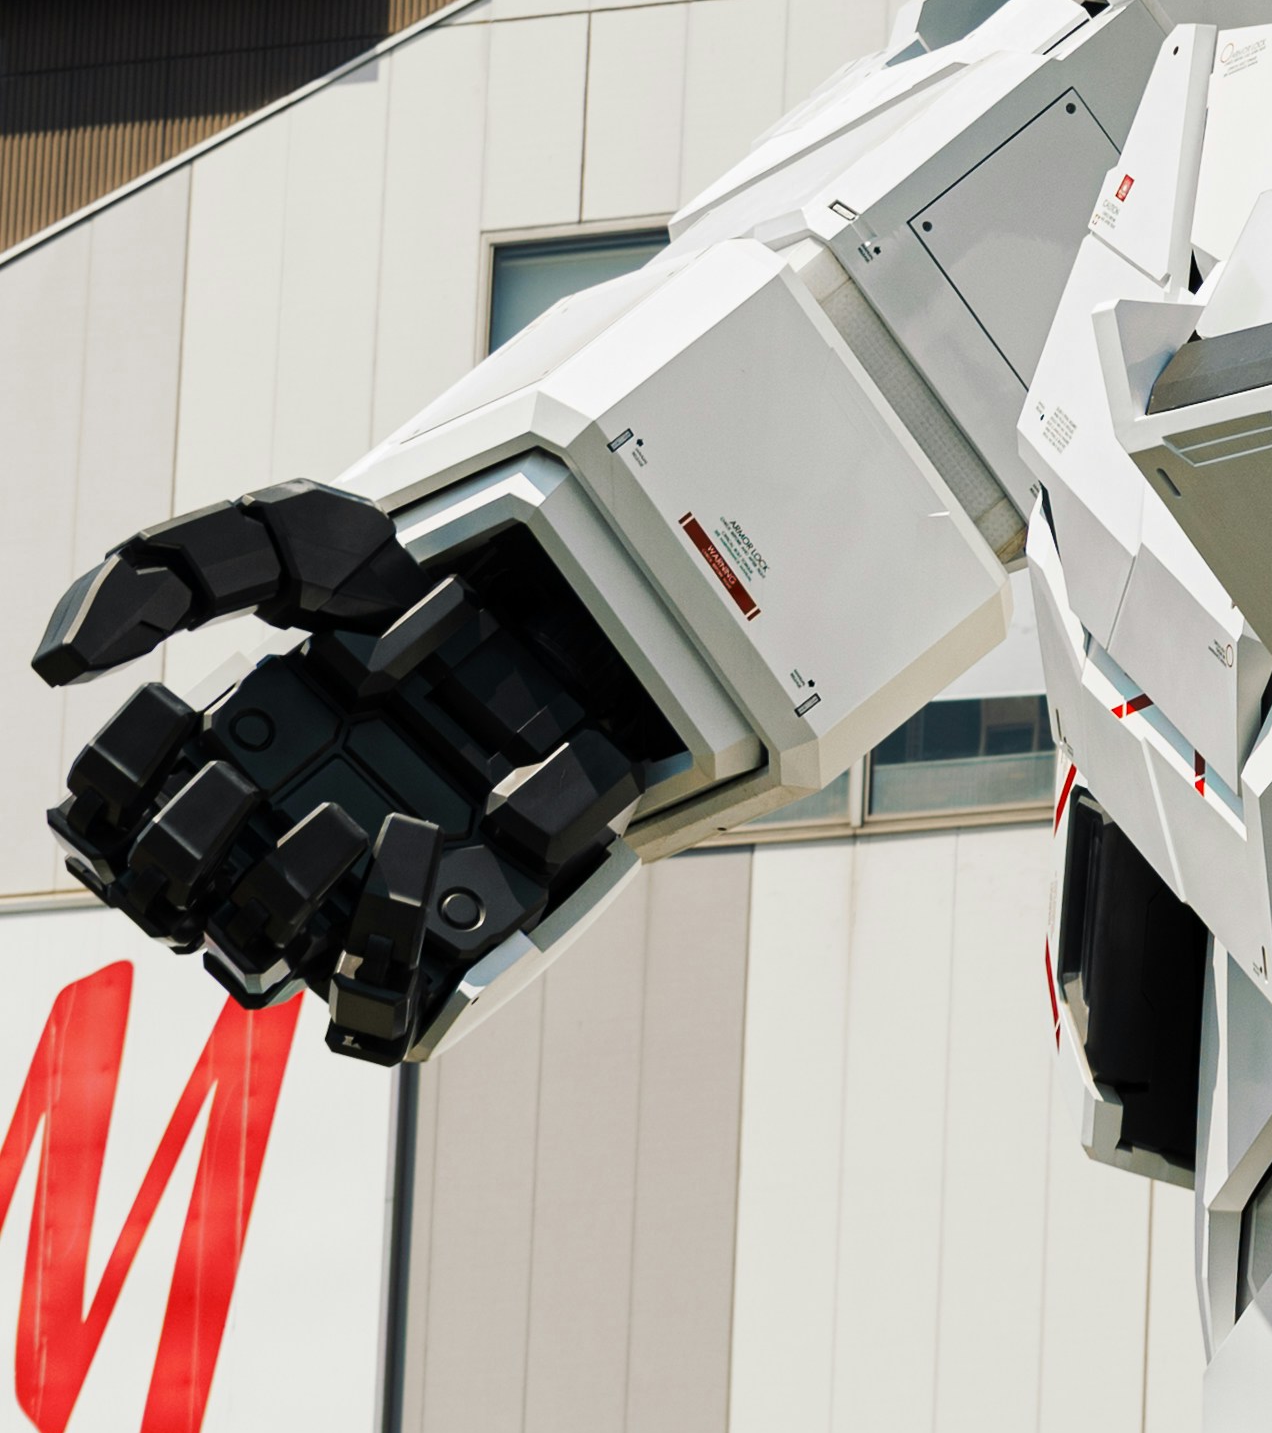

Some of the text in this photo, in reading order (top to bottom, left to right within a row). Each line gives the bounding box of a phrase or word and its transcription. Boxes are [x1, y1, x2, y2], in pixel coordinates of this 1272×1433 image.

[707, 545, 737, 585] WARNING
[729, 521, 769, 572] ARMOR LOCK
